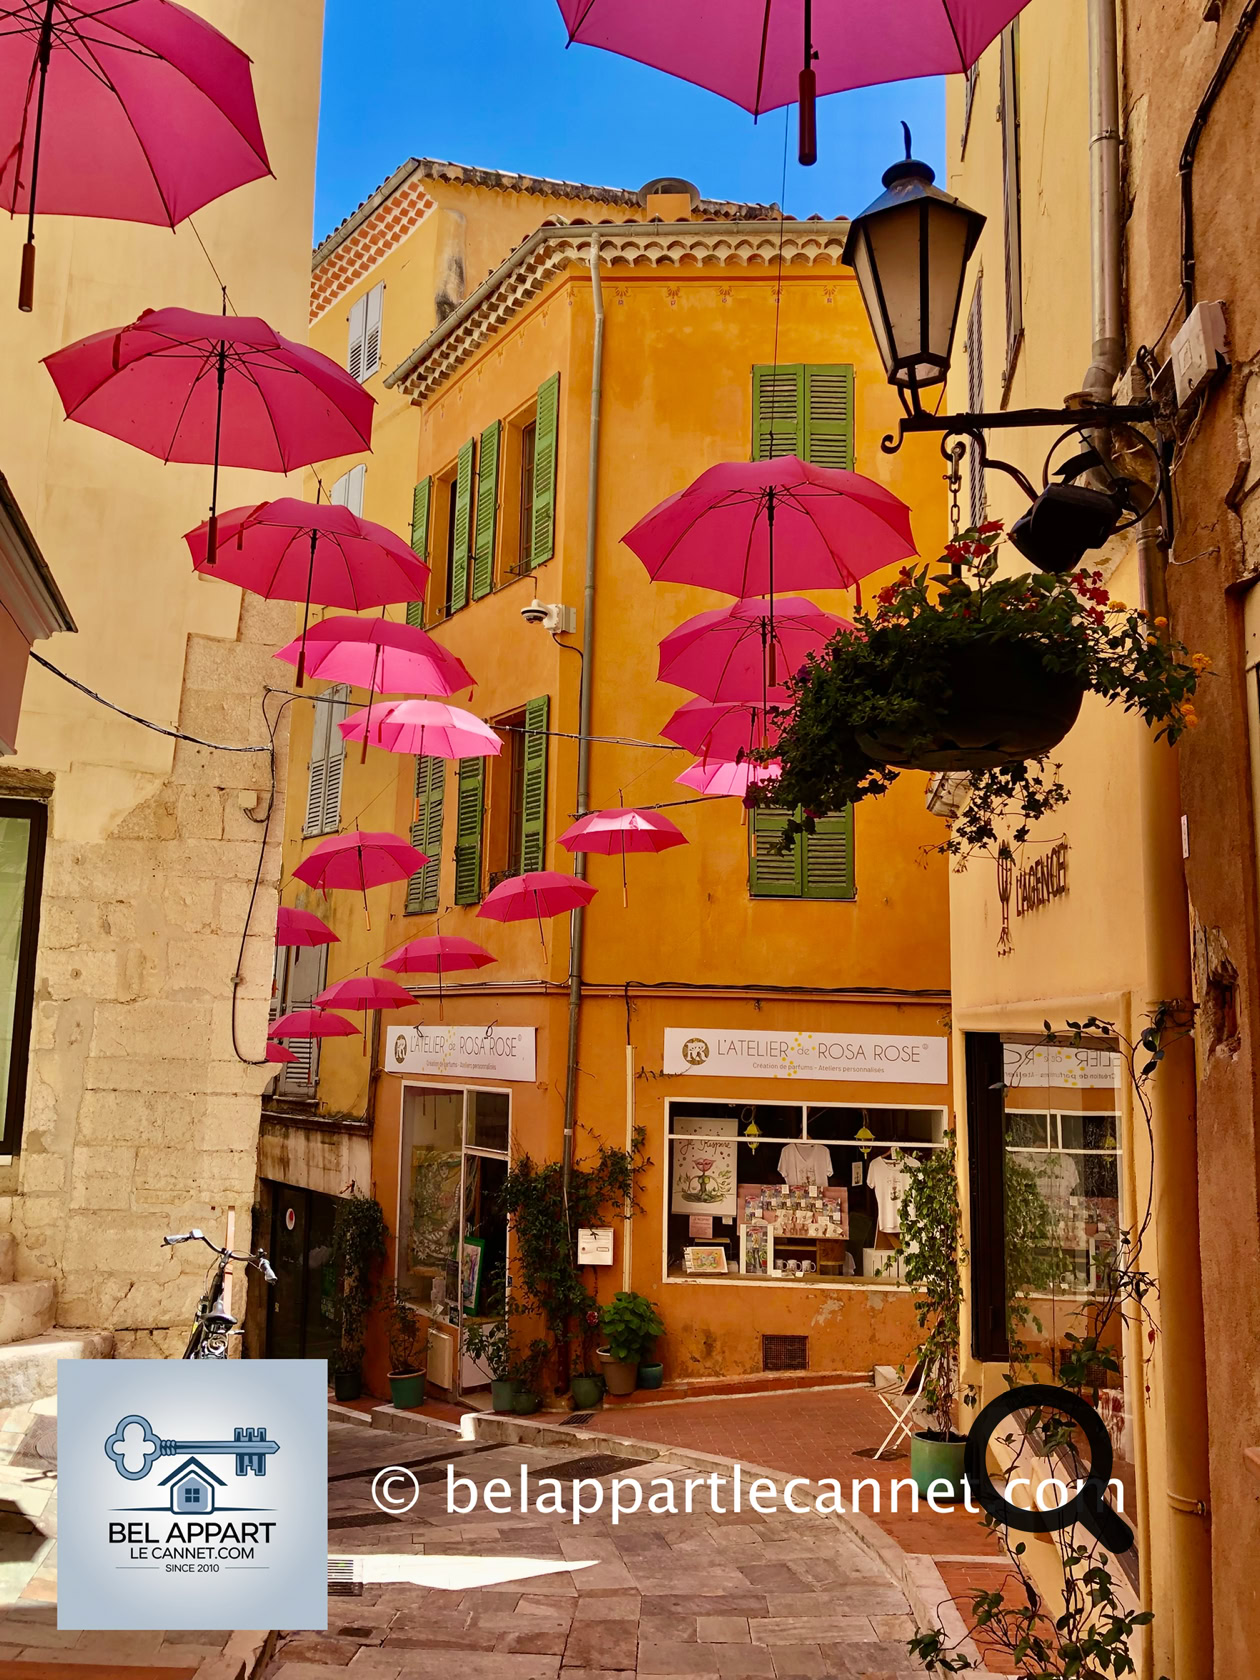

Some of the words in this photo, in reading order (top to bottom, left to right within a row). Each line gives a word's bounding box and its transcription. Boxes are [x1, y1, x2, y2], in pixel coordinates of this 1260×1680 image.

[1016, 842, 1068, 917] L'AGENCE
[410, 1036, 445, 1054] L'ATELIER
[460, 1036, 487, 1056] ROSA
[489, 1037, 517, 1057] ROSE
[717, 1039, 789, 1058] L'ATELIER
[797, 1046, 810, 1056] de
[818, 1043, 867, 1060] ROSA
[873, 1044, 920, 1062] ROSE
[752, 1062, 779, 1070] Création
